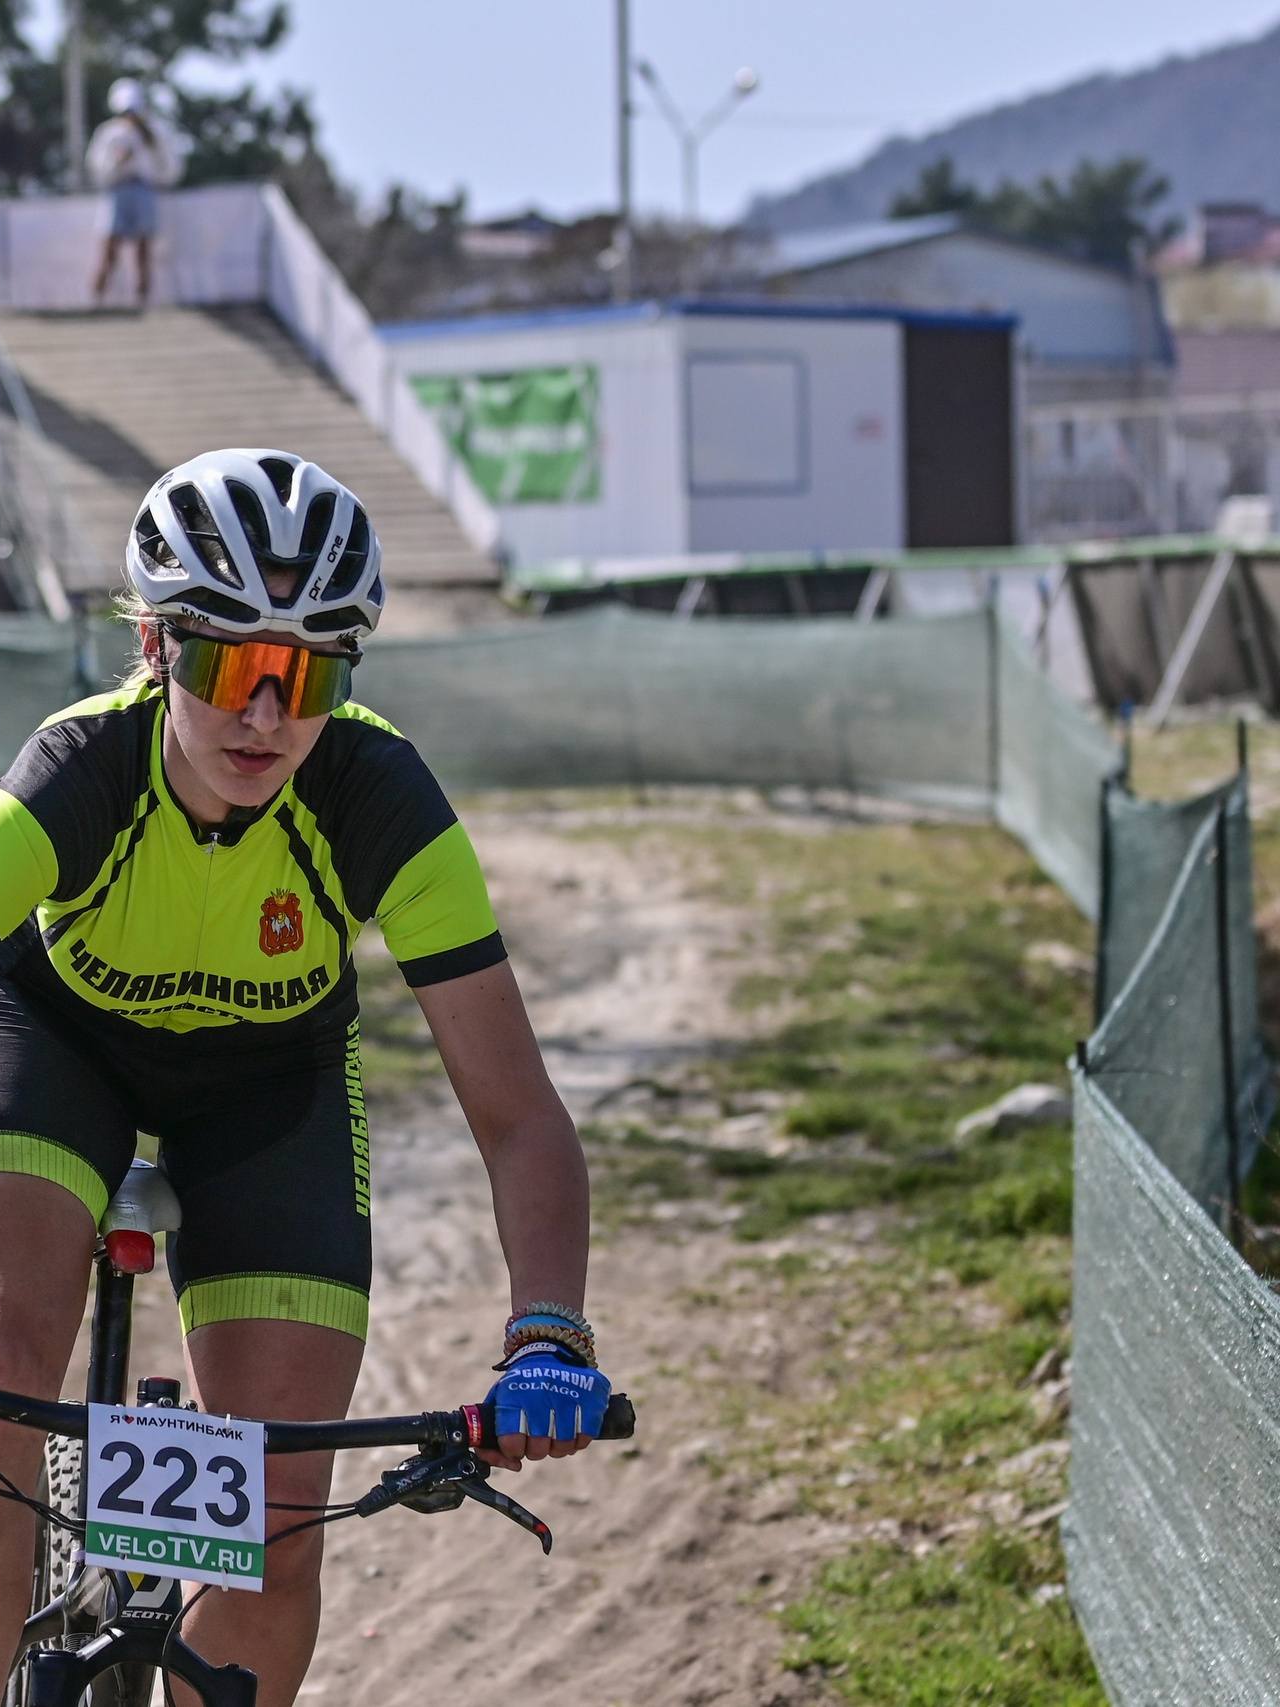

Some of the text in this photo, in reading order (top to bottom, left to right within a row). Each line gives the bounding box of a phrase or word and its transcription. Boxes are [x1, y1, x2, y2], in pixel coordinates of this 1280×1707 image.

[69, 938, 331, 1011] ЧЕЛЯБИНСКАЯ
[508, 1381, 580, 1399] COLNAGO
[521, 1367, 595, 1392] GAZPROM
[110, 1414, 120, 1424] Я
[97, 1441, 251, 1527] 223
[121, 1610, 173, 1621] SCOTT
